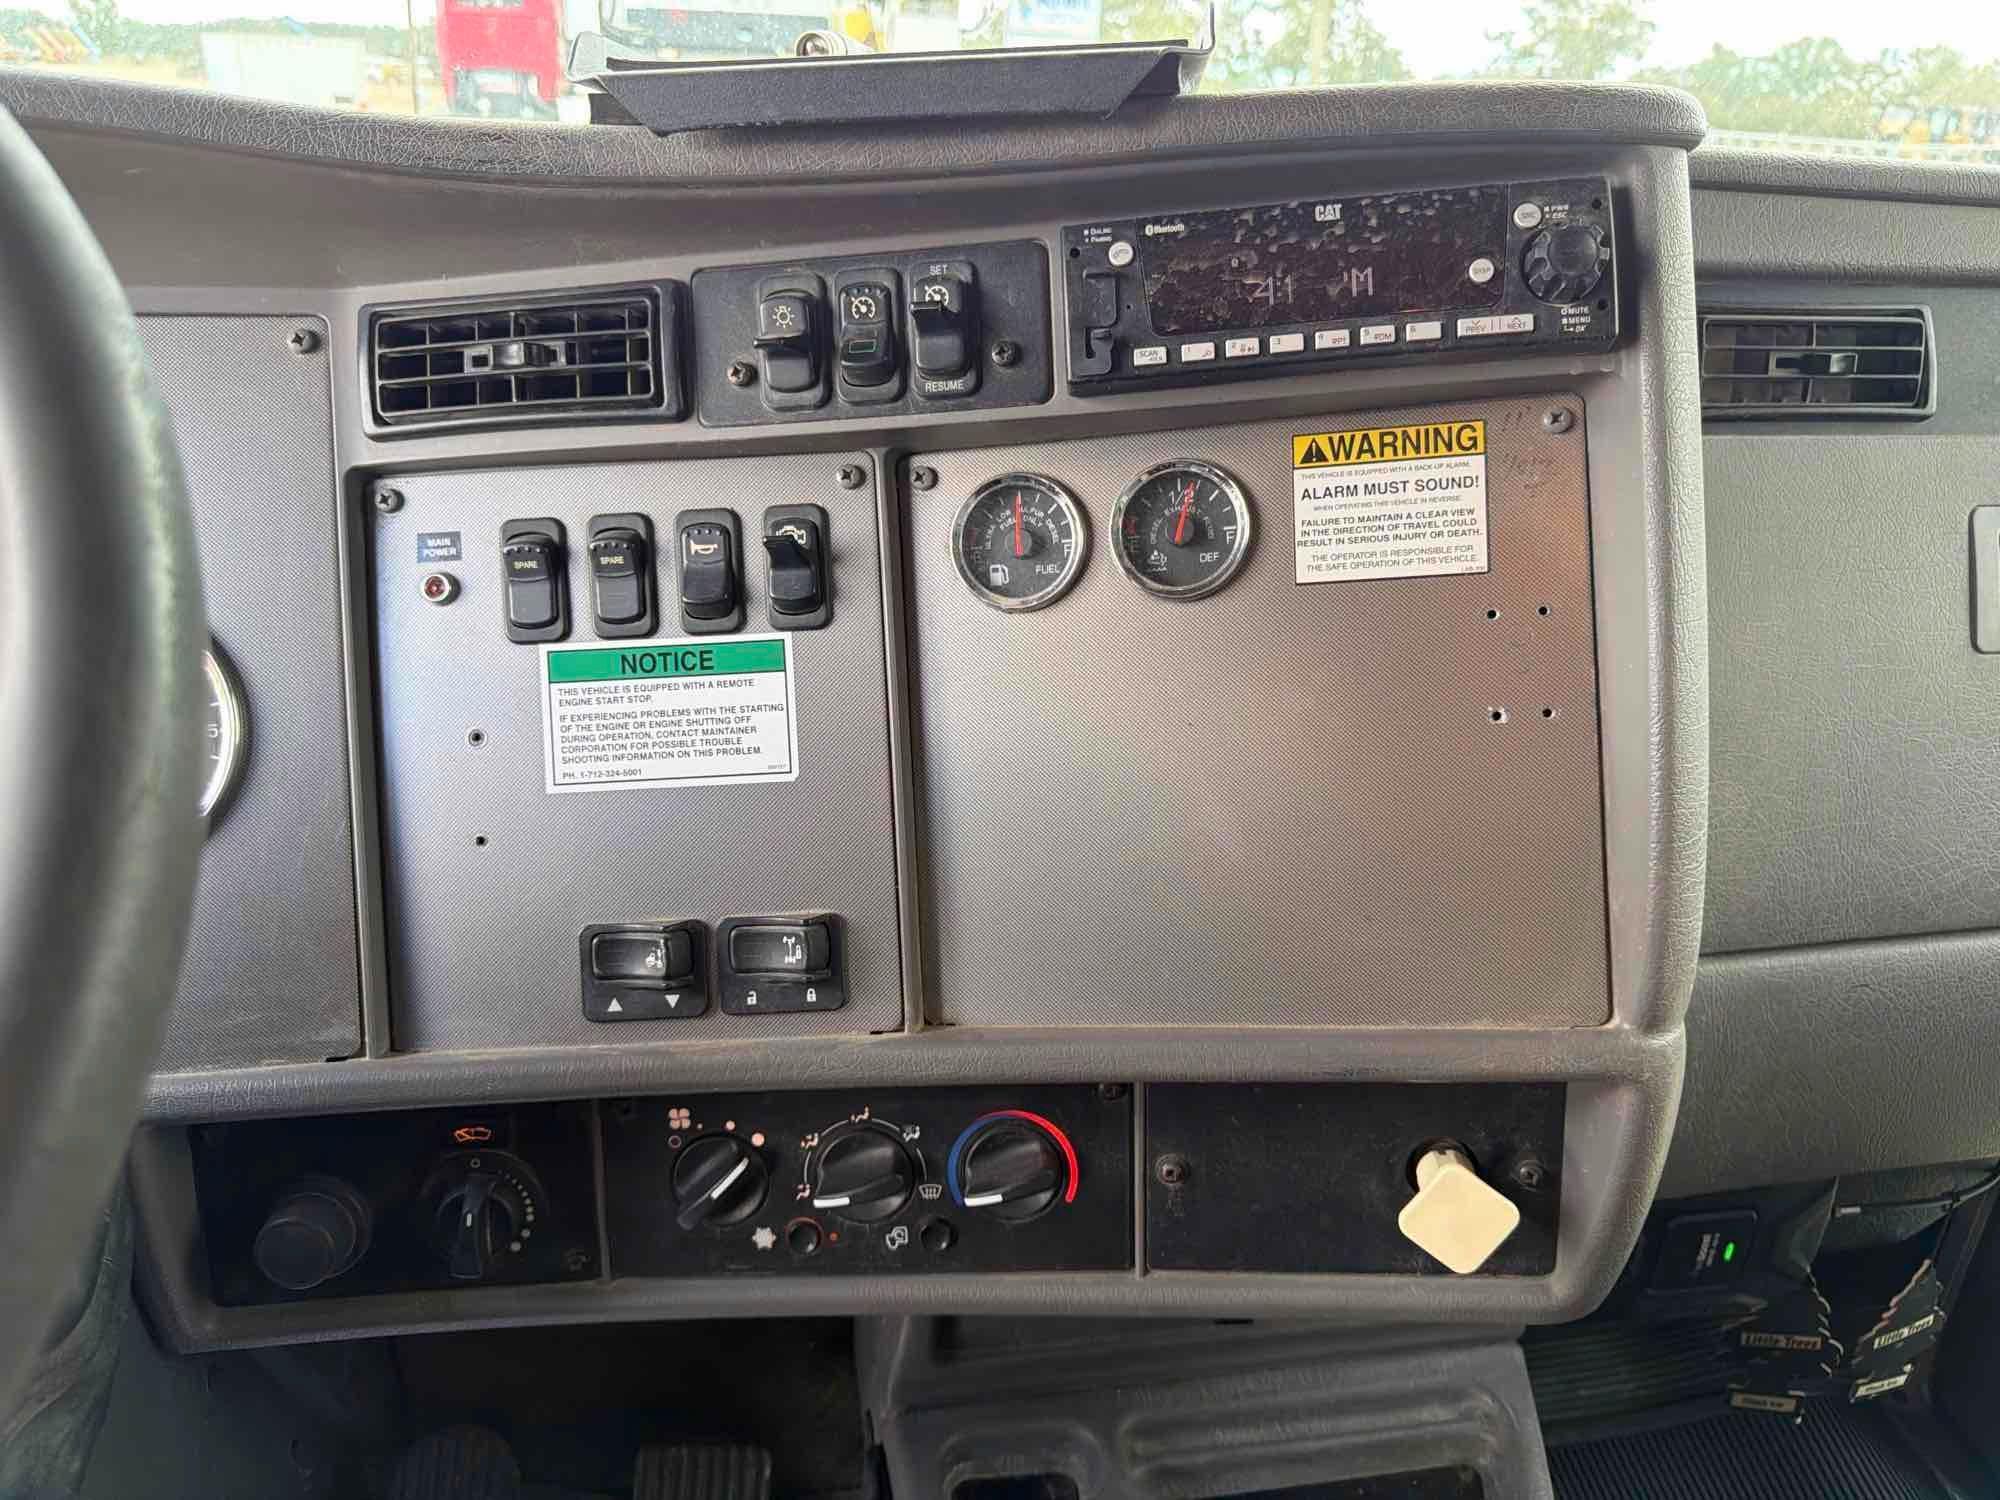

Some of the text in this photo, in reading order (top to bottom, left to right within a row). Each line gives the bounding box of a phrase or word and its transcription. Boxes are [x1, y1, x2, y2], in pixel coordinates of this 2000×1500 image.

[1315, 204, 1342, 221] CAT
[929, 265, 948, 276] SET
[1568, 307, 1590, 315] MUTE
[925, 380, 964, 392] RESUME
[1328, 424, 1478, 461] WARNING
[1355, 468, 1387, 476] EQUIPPED
[1301, 476, 1479, 500] ALARM MUST SOUND!
[1335, 502, 1373, 510] OPERATING
[1390, 499, 1417, 507] VEHICLE
[1302, 518, 1340, 527] FAILURE
[1358, 513, 1402, 523] MAINTAIN
[1416, 511, 1448, 519] CLEAR
[1451, 509, 1475, 517] VIEW
[1333, 525, 1384, 535] DIRECTION
[1403, 521, 1439, 530] TRAVEL
[1443, 518, 1476, 527] COULD
[428, 537, 451, 547] MAIN
[1226, 531, 1235, 544] F
[1297, 539, 1332, 547] RESULT
[1348, 535, 1390, 544] SERIOUS
[1393, 532, 1426, 541] INJURY
[1430, 531, 1444, 539] OR
[1447, 529, 1483, 537] DEATH.
[423, 547, 457, 557] POWER
[1200, 552, 1220, 563] DEF
[1313, 554, 1328, 562] THE
[1330, 551, 1377, 561] OPERATOR
[1390, 546, 1452, 557] RESPONSIBLE
[514, 560, 538, 569] SPARE
[600, 556, 624, 565] SPARE
[1308, 564, 1323, 572] THE
[1326, 562, 1348, 571] SAFE
[1351, 559, 1399, 570] OPERATION
[1402, 558, 1417, 566] OF
[1417, 557, 1437, 565] THIS
[1036, 564, 1060, 575] FUEL
[620, 650, 714, 674] NOTICE
[559, 679, 754, 696] THIS VEHICLE IS EQUIPPED WITH A REMOTE
[559, 698, 593, 706] ENGINE
[596, 696, 624, 705] START
[571, 711, 638, 722] EXPERIENCING
[640, 709, 691, 718] PROBLEMS
[694, 707, 717, 716] WITH
[719, 706, 737, 714] THE
[740, 704, 784, 713] STARTING
[560, 725, 572, 733] OF
[575, 724, 593, 732] THE
[596, 722, 630, 731] ENGINE
[649, 720, 683, 729] ENGINE
[686, 717, 731, 727] SHUTTING
[735, 716, 751, 724] OFF
[561, 735, 596, 744] DURING
[656, 729, 698, 739] CONTACT
[702, 726, 757, 736] MAINTAINER
[562, 737, 742, 754] CORPORATION FOR POSSIBLE TROUBLE
[562, 754, 609, 764] SHOOTING
[612, 752, 675, 762] INFORMATION
[678, 751, 691, 759] ON
[694, 749, 713, 757] THIS
[581, 769, 642, 778] 1-712-324-5001
